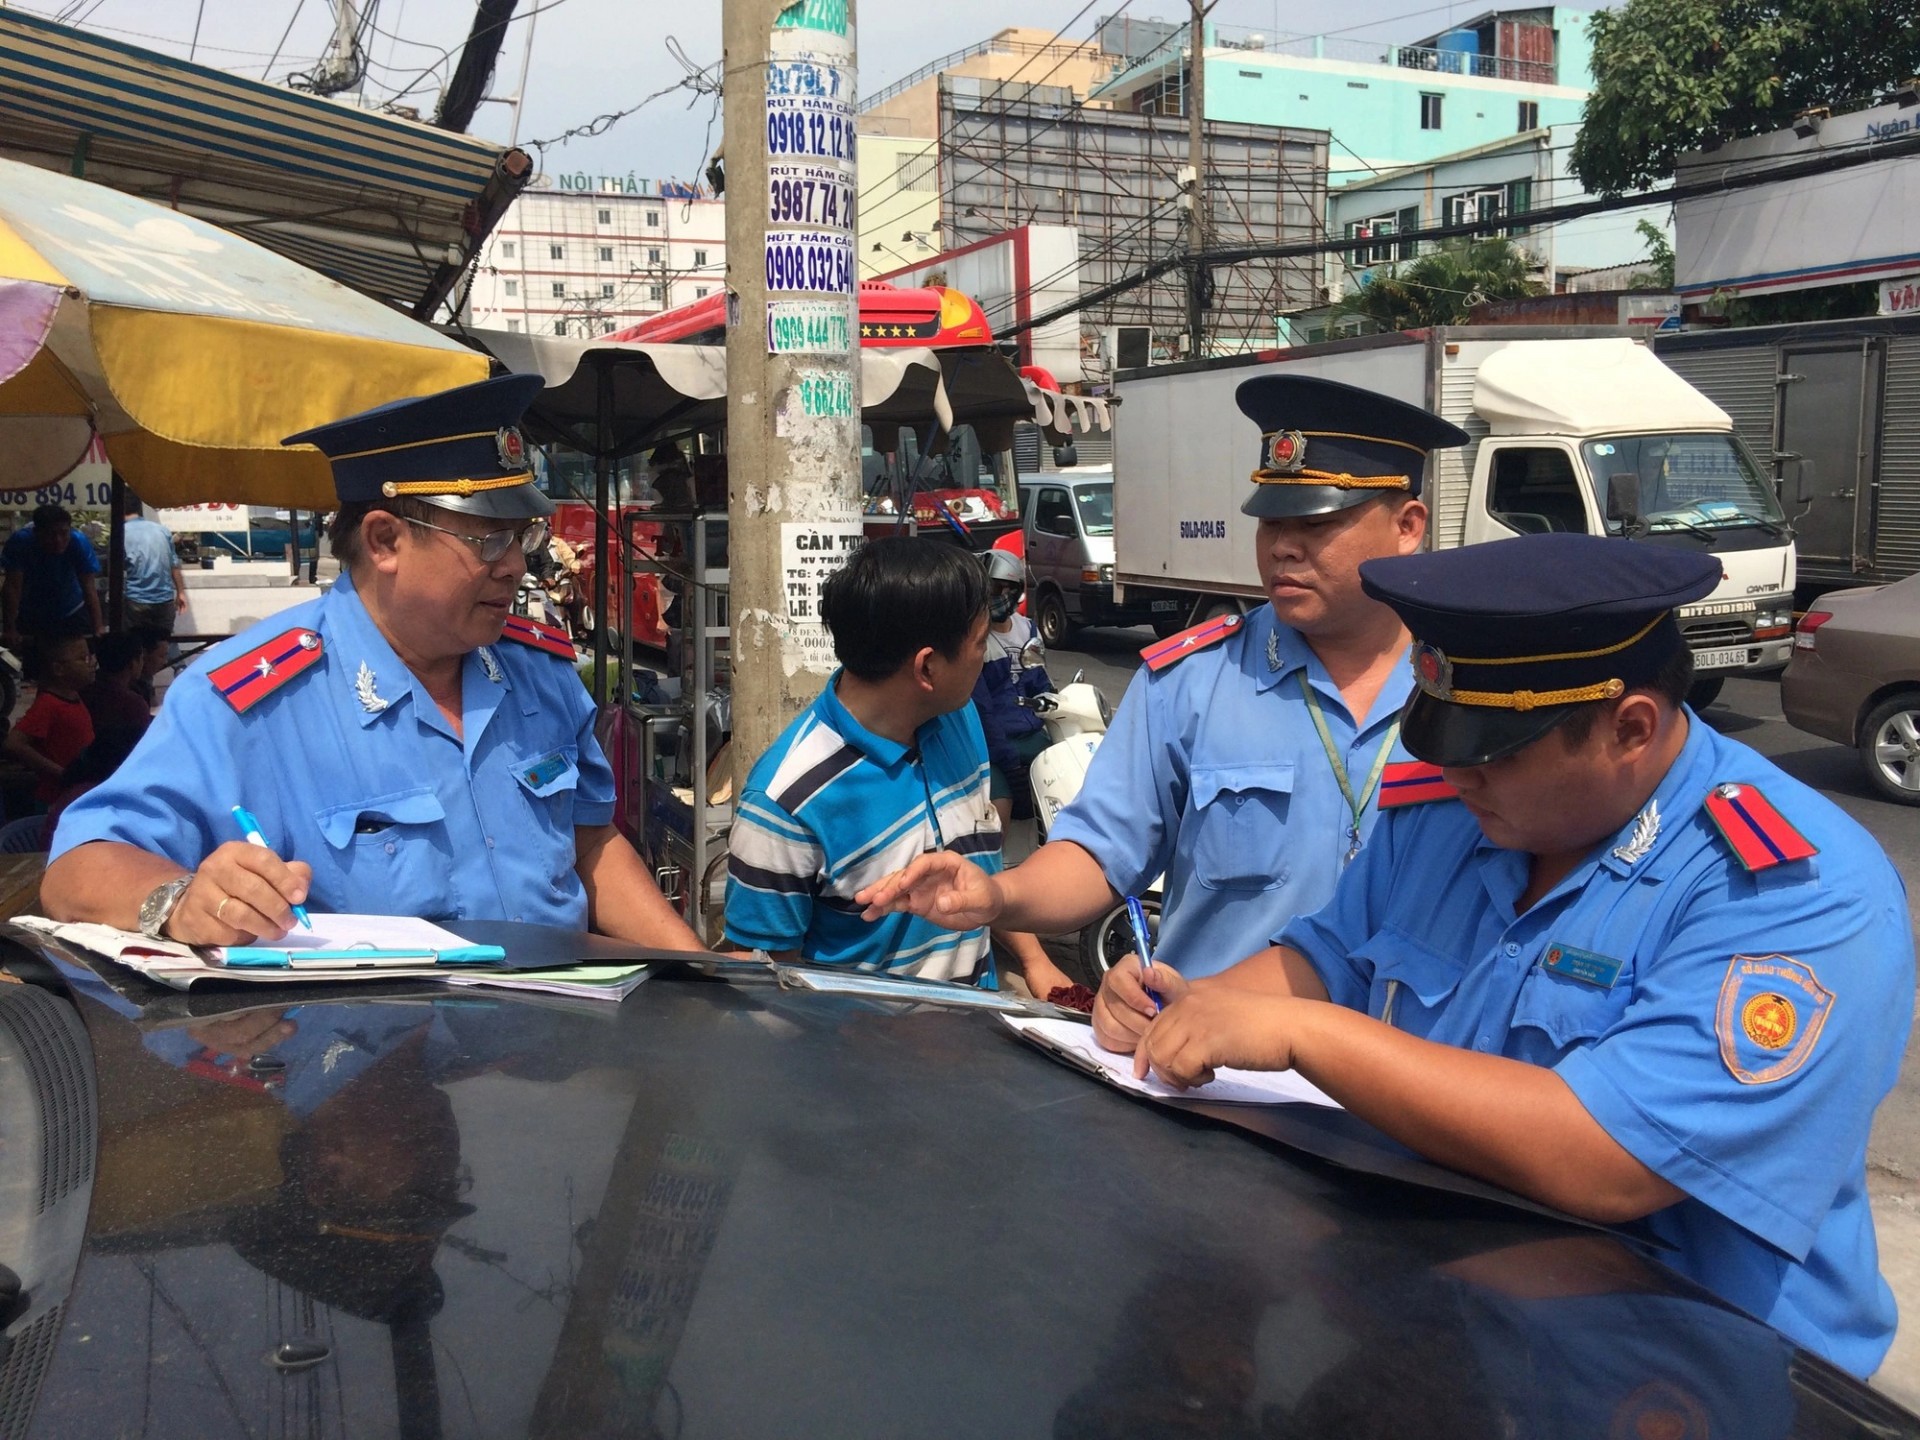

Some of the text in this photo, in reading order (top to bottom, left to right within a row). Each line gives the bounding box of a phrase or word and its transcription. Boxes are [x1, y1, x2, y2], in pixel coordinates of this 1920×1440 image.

[559, 171, 592, 191] NỘI
[597, 170, 650, 194] THẤT
[796, 529, 833, 550] CẦN
[801, 556, 816, 564] NV
[787, 569, 811, 578] TG:
[787, 583, 811, 596] TN:
[1746, 583, 1780, 594] CANTER
[789, 600, 811, 616] LH:
[1695, 651, 1746, 667] 50LD-034.65
